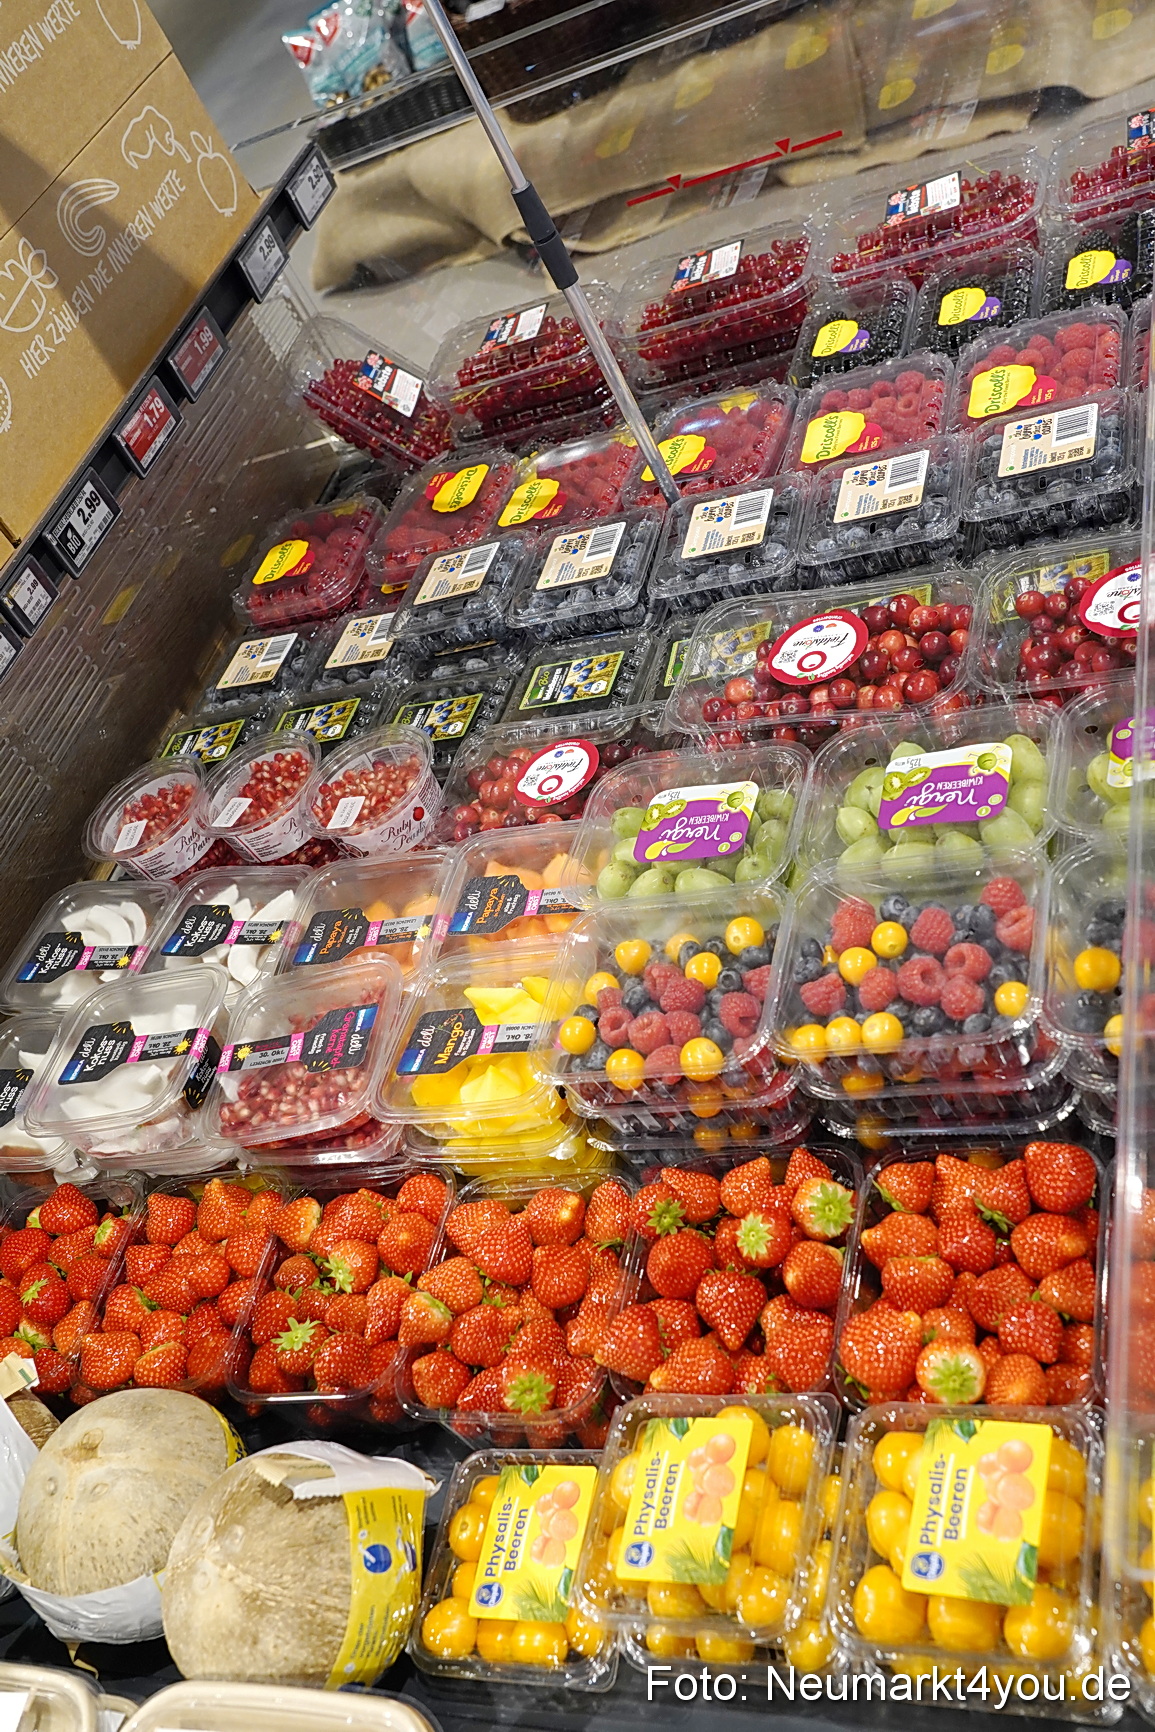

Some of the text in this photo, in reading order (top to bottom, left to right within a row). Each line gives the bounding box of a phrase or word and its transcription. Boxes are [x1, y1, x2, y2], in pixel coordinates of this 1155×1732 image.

[37, 0, 80, 42] WERTE
[258, 234, 276, 261] 2.99
[19, 169, 186, 379] HIER ZÄHLEN DIE INNEREN WERTE
[1076, 253, 1092, 287] Driscoll's
[948, 291, 965, 323] Driscoll's
[194, 326, 213, 354] 1.99
[821, 322, 841, 355] Driscoll's
[984, 369, 1006, 414] Driscoll's
[144, 397, 165, 428] 1.79
[816, 415, 839, 460] Driscoll's
[449, 467, 477, 510] Driscoll's
[509, 481, 541, 523] Driscoll's
[77, 490, 101, 526] 2.99
[67, 535, 81, 555] BIO
[262, 541, 293, 582] Driscoll's
[27, 579, 39, 596] 2.99
[538, 670, 550, 687] Bio
[284, 716, 295, 731] Bio
[402, 710, 413, 726] Bio
[172, 738, 184, 753] Bio
[906, 757, 922, 768] 125g
[380, 819, 412, 842] Ruby
[392, 821, 427, 851] Pearls
[464, 889, 481, 910] deli
[476, 887, 499, 924] Papaya
[531, 895, 540, 911] OBST
[181, 916, 197, 935] deli
[184, 915, 208, 948] Kokos-
[198, 920, 216, 943] nuss
[230, 925, 241, 941] OBST
[310, 922, 326, 942] deli
[319, 920, 343, 955] Papaya
[372, 926, 380, 941] OBST
[37, 943, 51, 962] deli
[38, 943, 61, 975] Kokos-
[51, 946, 68, 971] nuss
[78, 1037, 96, 1059] deli
[135, 1040, 145, 1059] OBST
[198, 1033, 208, 1053] OBST
[290, 1040, 298, 1057] OBST
[325, 1028, 342, 1053] kerne
[330, 1011, 357, 1068] Granatapfel-
[348, 1034, 364, 1055] deli
[417, 1025, 436, 1047] deli
[433, 1021, 463, 1065] Mango
[486, 1031, 496, 1049] OBST
[83, 1035, 108, 1072] Kokos-
[97, 1040, 116, 1066] nuss
[634, 1450, 661, 1536] Physalis-
[654, 1463, 680, 1530] Beeren
[919, 1453, 945, 1546] Physalis-
[944, 1468, 968, 1541] Beeren
[485, 1496, 513, 1578] Physalis-
[503, 1508, 529, 1571] Beeren
